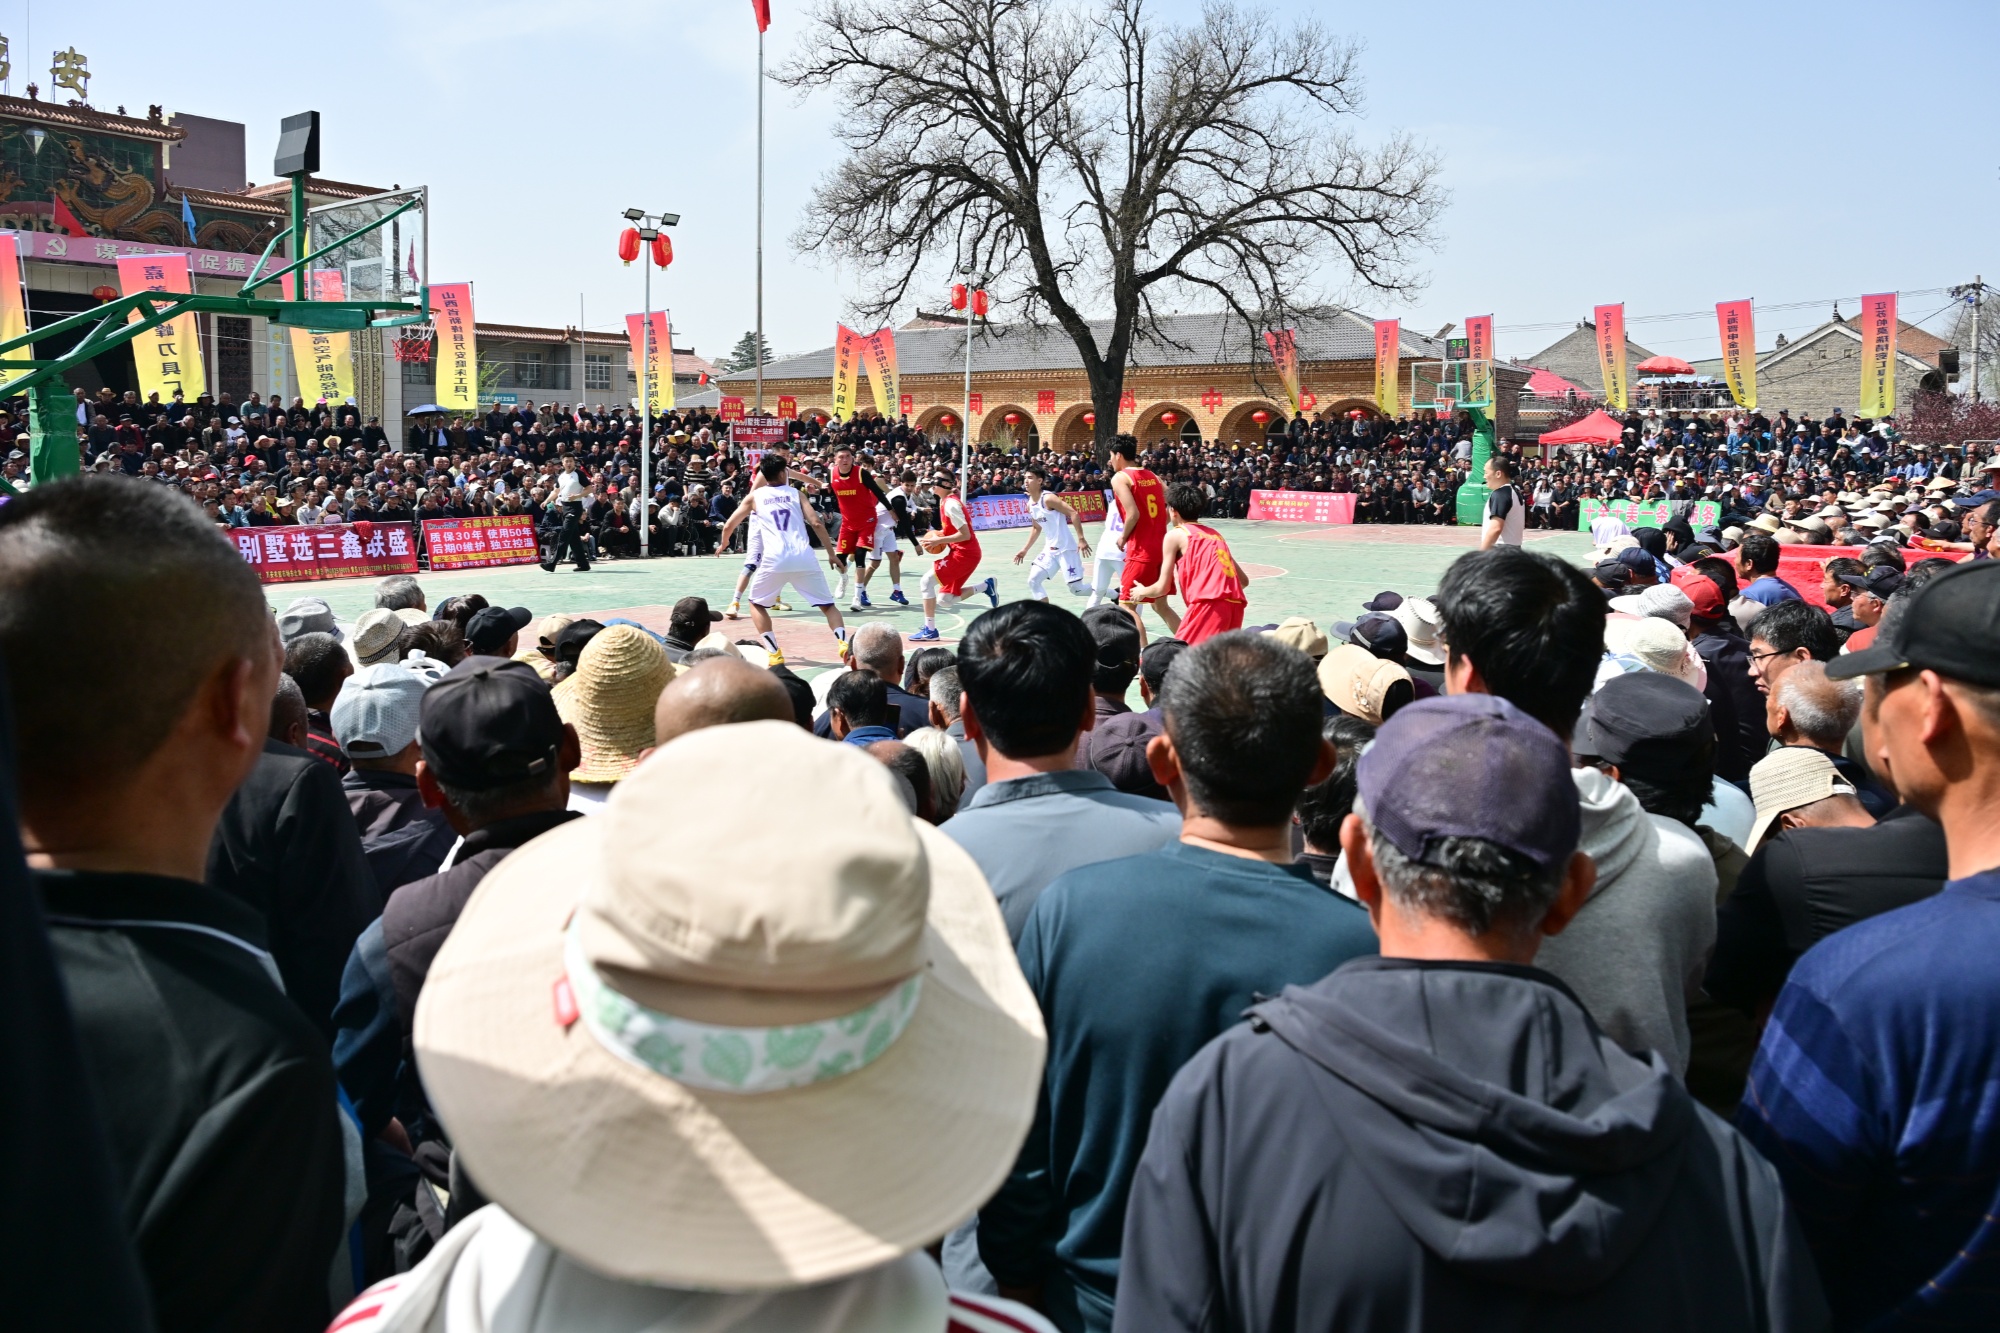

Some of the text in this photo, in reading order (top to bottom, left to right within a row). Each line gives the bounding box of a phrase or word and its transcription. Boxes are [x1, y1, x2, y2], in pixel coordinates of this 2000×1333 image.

[1146, 493, 1158, 519] 6
[1583, 502, 1716, 526] 十全十美一条服务
[770, 509, 791, 532] 17
[238, 529, 410, 564] 别墅选三鑫联盛
[430, 527, 532, 543] 质保30年 使用50年
[432, 537, 535, 555] 后期0维护 独立控温
[1216, 548, 1237, 579] 9
